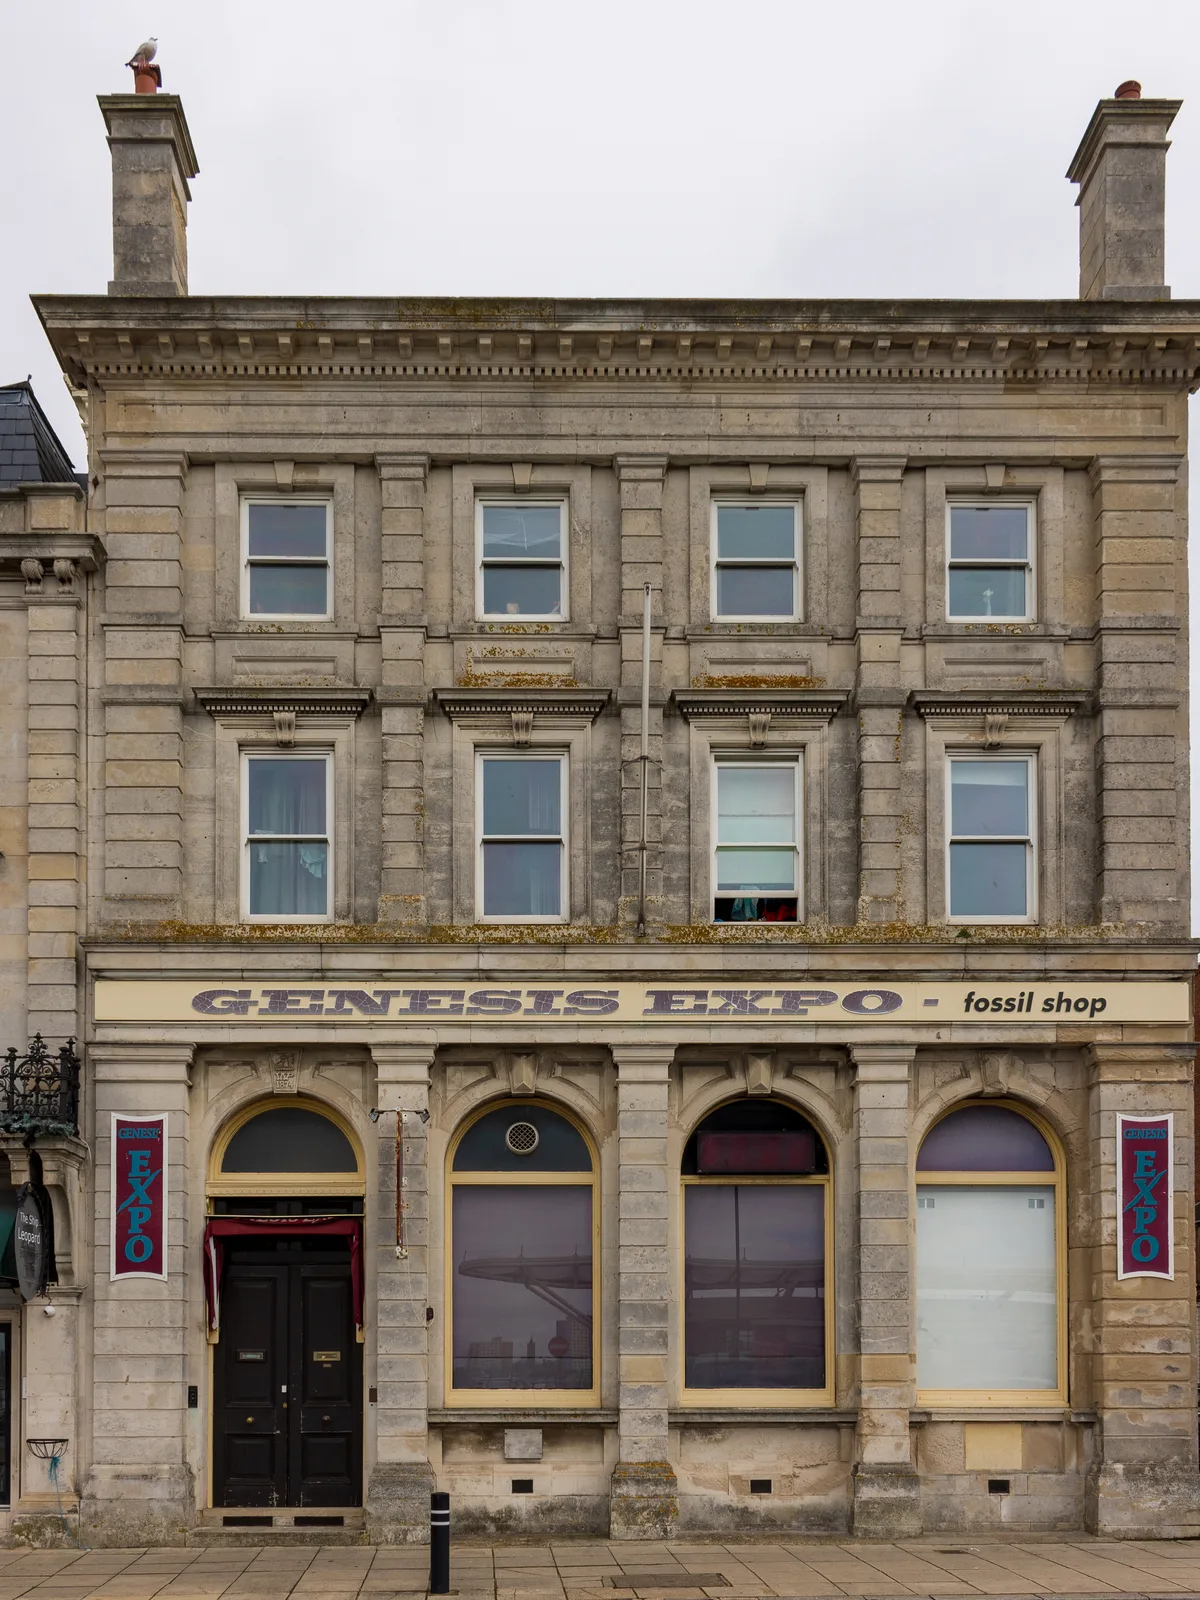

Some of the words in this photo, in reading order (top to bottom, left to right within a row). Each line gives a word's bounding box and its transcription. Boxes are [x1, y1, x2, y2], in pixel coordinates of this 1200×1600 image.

[191, 989, 620, 1016] GENESIS
[642, 989, 903, 1016] EXPO
[963, 990, 1033, 1013] fossil
[1041, 991, 1108, 1018] shop
[1123, 1128, 1167, 1139] GENESIS
[117, 1151, 162, 1263] EXPO
[1123, 1151, 1167, 1262] EXPO
[20, 1211, 28, 1224] The
[29, 1215, 39, 1227] Ship
[18, 1227, 40, 1244] Leopard
